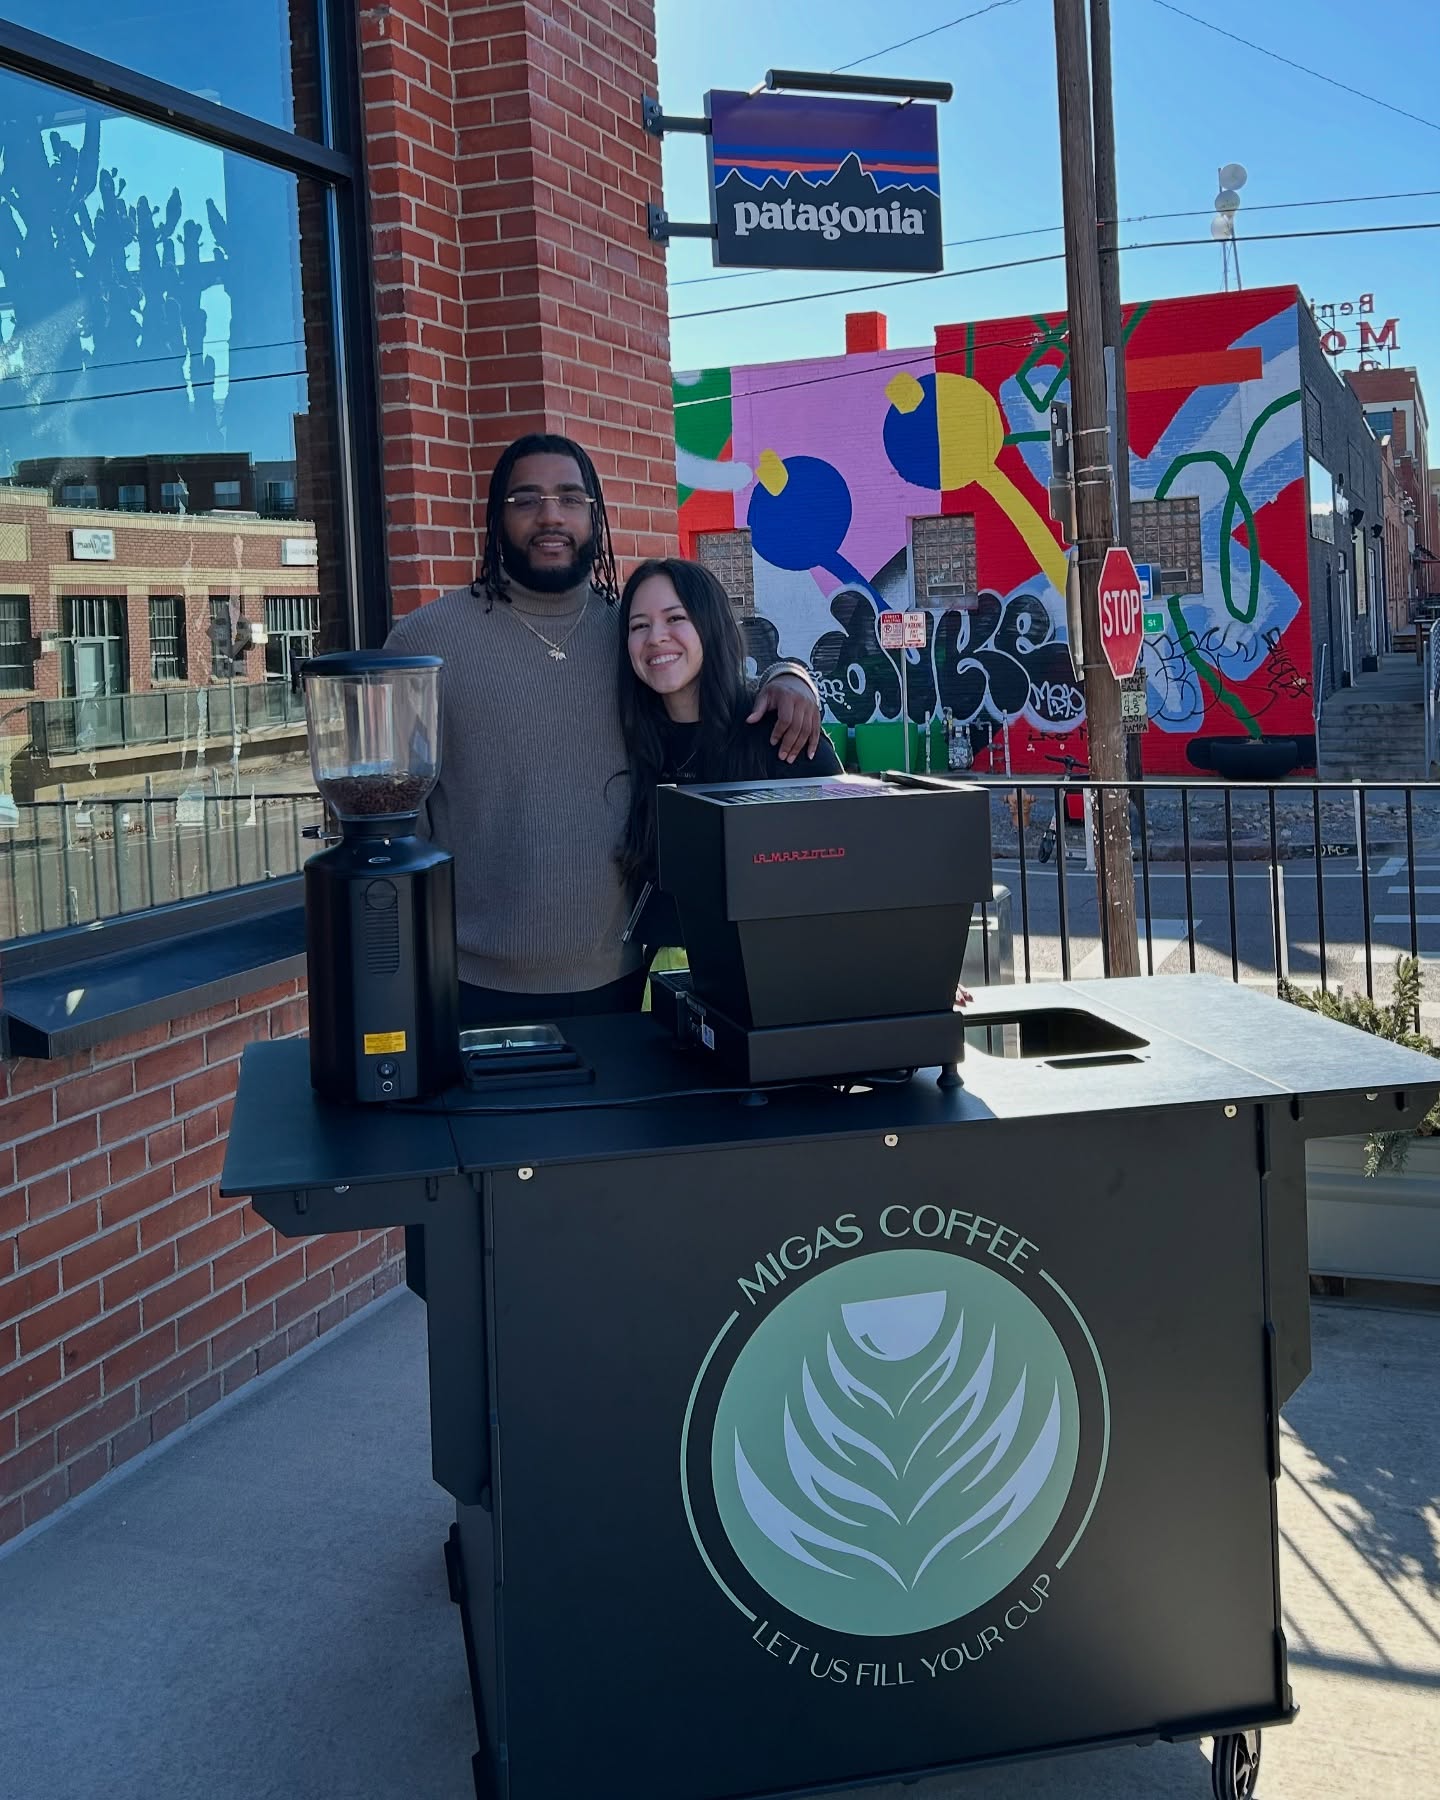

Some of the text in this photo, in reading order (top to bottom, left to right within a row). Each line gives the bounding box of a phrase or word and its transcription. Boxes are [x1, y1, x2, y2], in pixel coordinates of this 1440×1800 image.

[734, 198, 924, 240] patagonia
[1102, 588, 1140, 638] STOP
[1147, 618, 1157, 627] St
[1121, 684, 1142, 692] SALE
[1123, 704, 1140, 714] 9-5
[737, 1204, 1040, 1305] MIGAS COFFEE
[752, 1573, 1050, 1686] LET US FILL YOUR CUP
